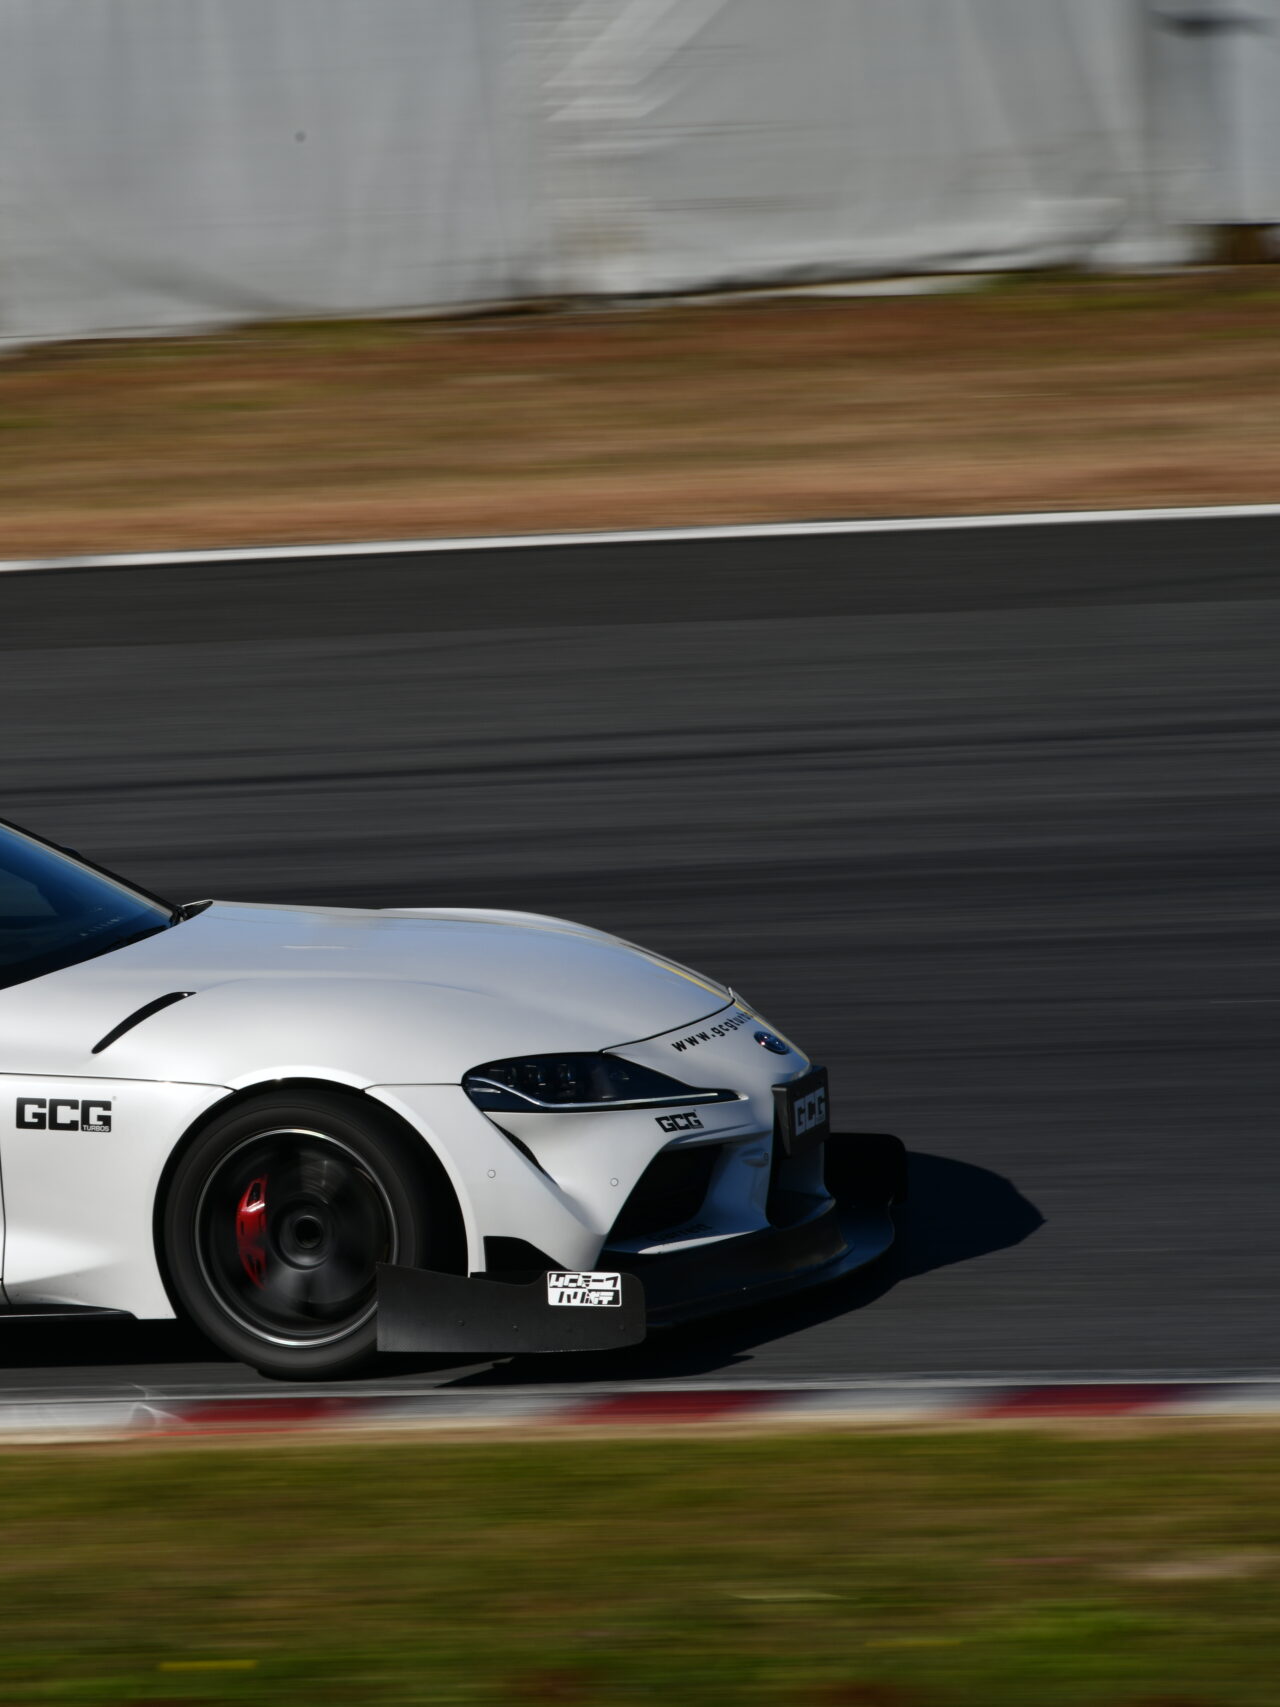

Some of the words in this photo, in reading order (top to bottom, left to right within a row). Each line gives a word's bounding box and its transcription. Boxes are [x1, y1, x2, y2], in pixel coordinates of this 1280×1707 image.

[16, 1097, 112, 1132] GCG
[655, 1112, 704, 1133] GCG
[83, 1124, 110, 1132] TURBOS
